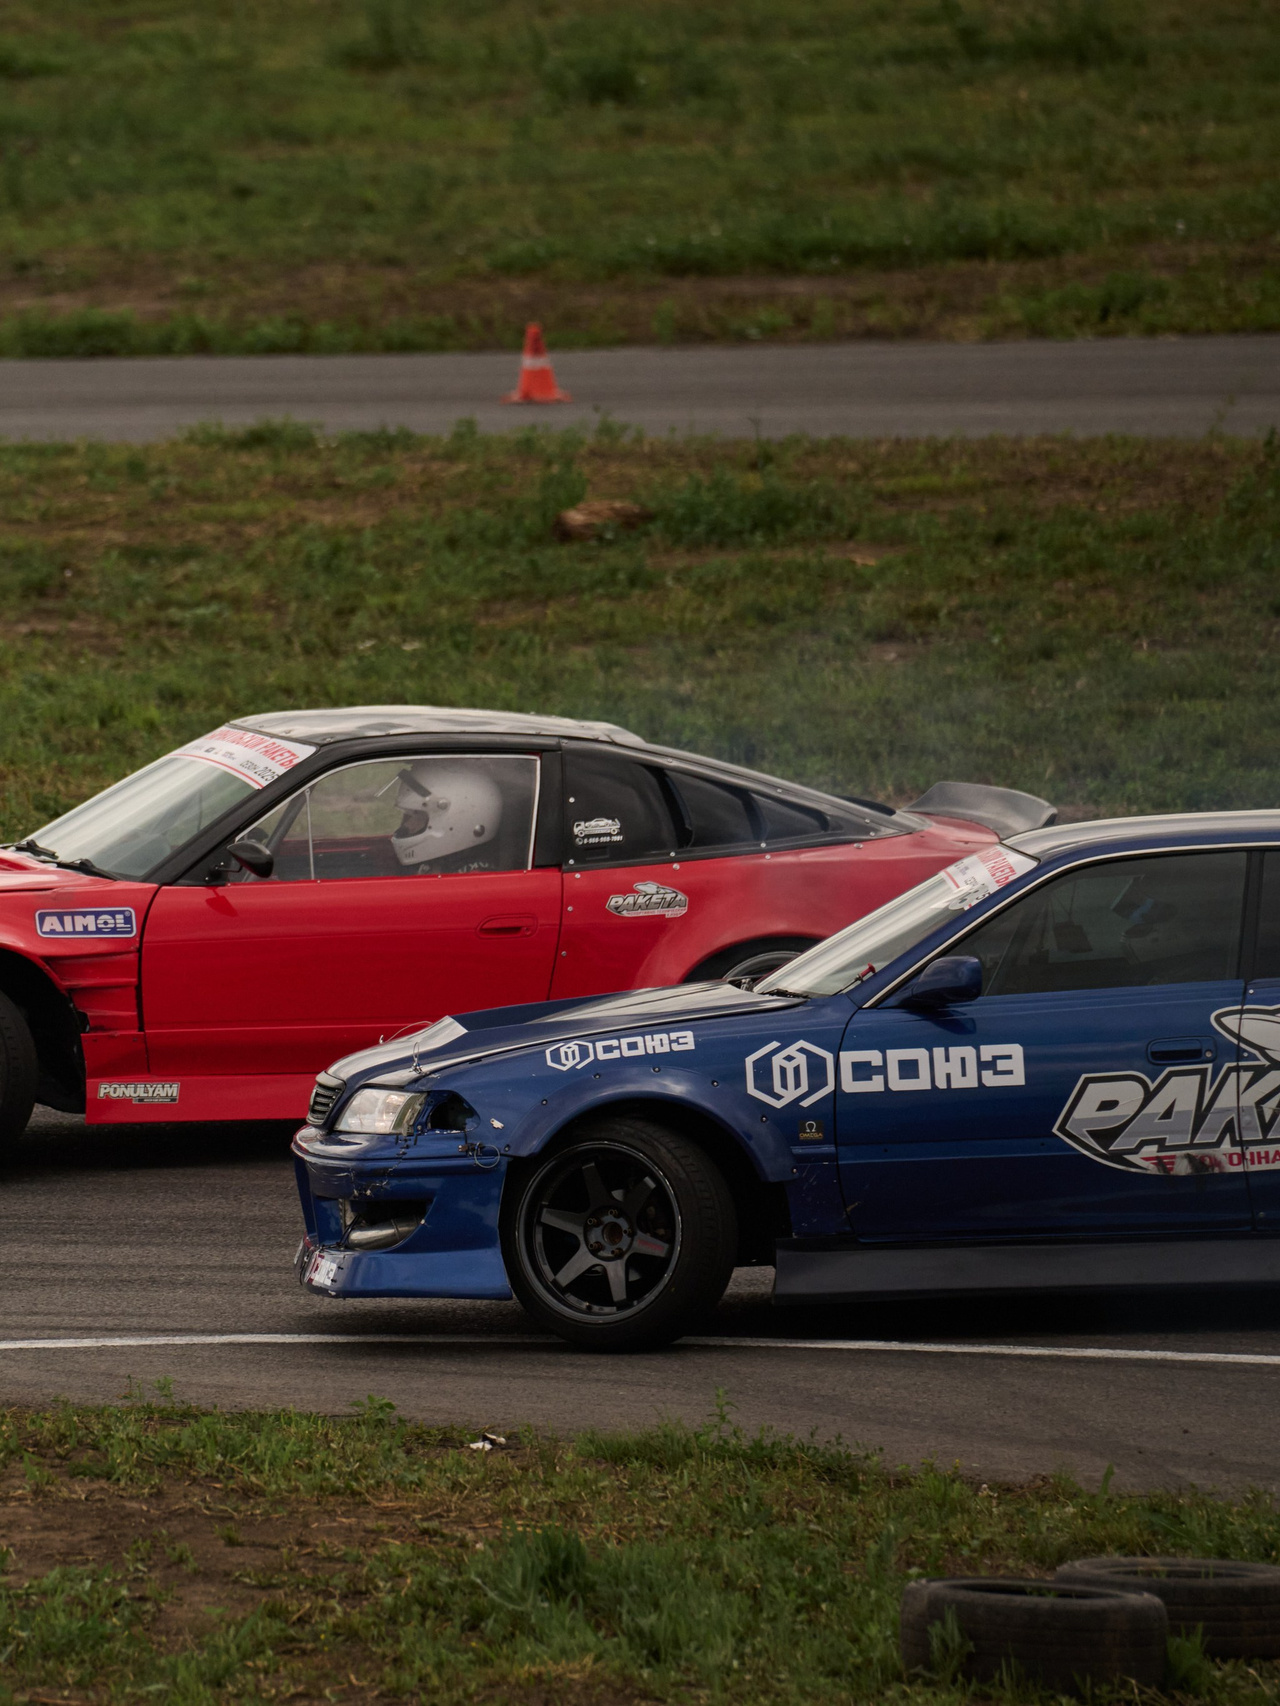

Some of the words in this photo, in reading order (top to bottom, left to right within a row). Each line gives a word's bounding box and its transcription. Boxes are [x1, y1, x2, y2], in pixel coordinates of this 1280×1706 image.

[42, 914, 131, 932] AIMOL
[596, 1031, 695, 1061] СОЮЗ
[839, 1043, 1026, 1093] СОЮЗ
[99, 1084, 178, 1098] PONULYAM
[1060, 1067, 1280, 1156] РАК
